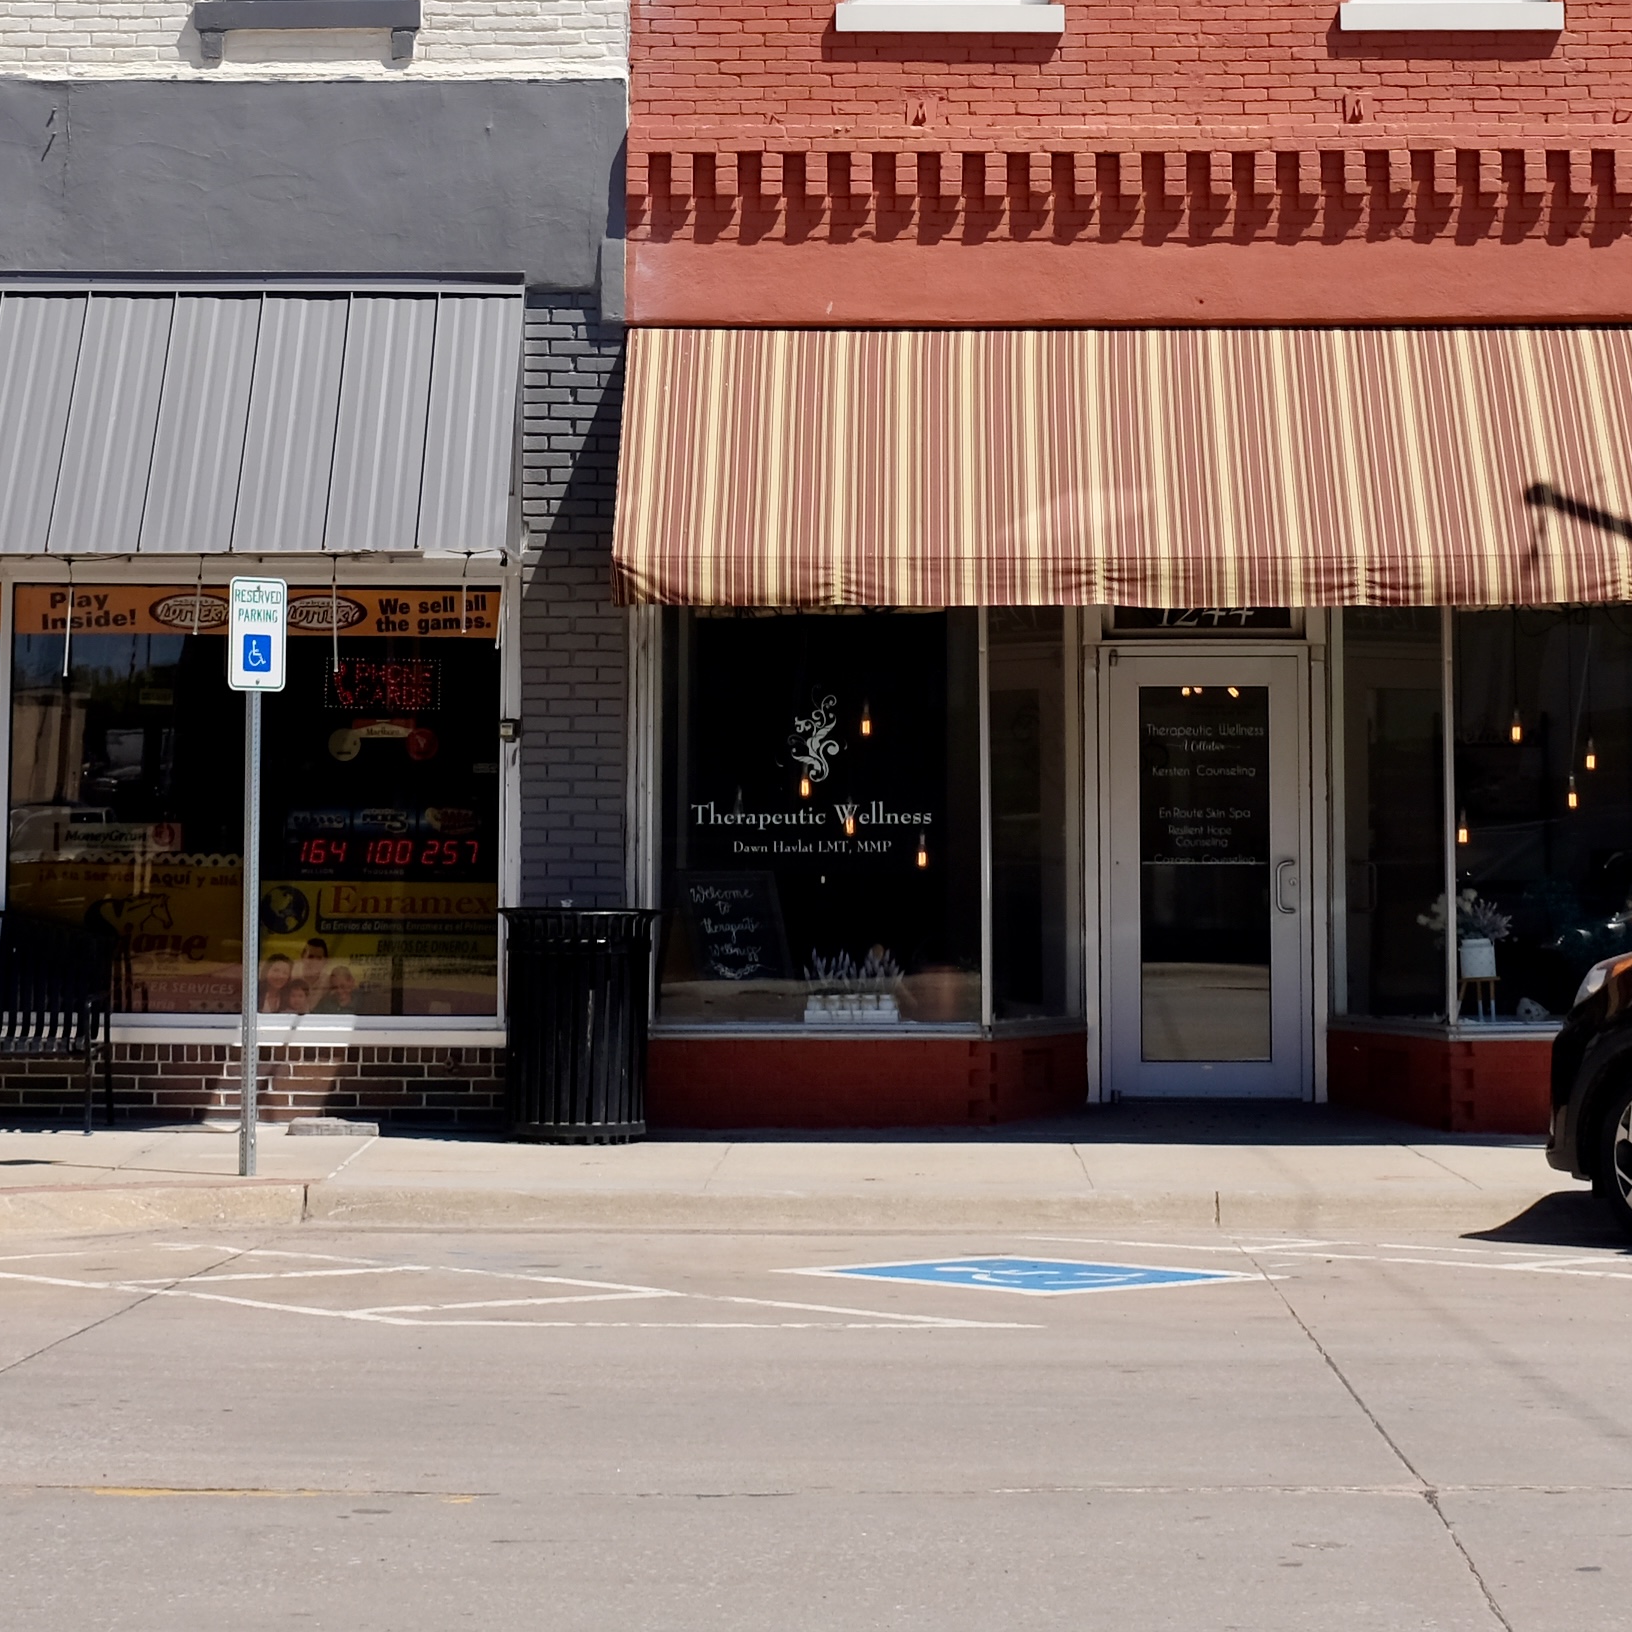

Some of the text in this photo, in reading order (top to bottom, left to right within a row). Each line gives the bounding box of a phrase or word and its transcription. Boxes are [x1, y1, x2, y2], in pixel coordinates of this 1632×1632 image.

[50, 592, 109, 610] Play
[234, 587, 282, 605] RESERVED
[378, 594, 488, 615] We sell all
[41, 609, 136, 630] Inside!
[157, 603, 229, 621] LOTTERY
[238, 608, 278, 625] PARKING
[287, 605, 357, 624] LOTTERY
[376, 616, 492, 635] the games.
[355, 664, 432, 684] PHONE
[355, 685, 432, 705] CARDS
[1146, 723, 1264, 738] Therapeutic Wellness
[1152, 765, 1256, 777] Kersten Counseling
[690, 800, 932, 830] Therapeutic Wellness
[1172, 807, 1203, 818] Route
[1205, 807, 1225, 818] Skin
[1229, 808, 1251, 820] Spa
[64, 829, 147, 843] MoneyGram
[1207, 825, 1232, 837] Hope
[733, 839, 892, 854] Dawn Havlat LMT, MMP
[1175, 836, 1228, 849] Counseling
[300, 840, 480, 865] 164 100 257
[196, 875, 206, 889] y
[329, 885, 495, 915] Enramex
[690, 885, 754, 904] Welcome
[362, 921, 372, 932] de
[172, 983, 235, 995] SERVICES
